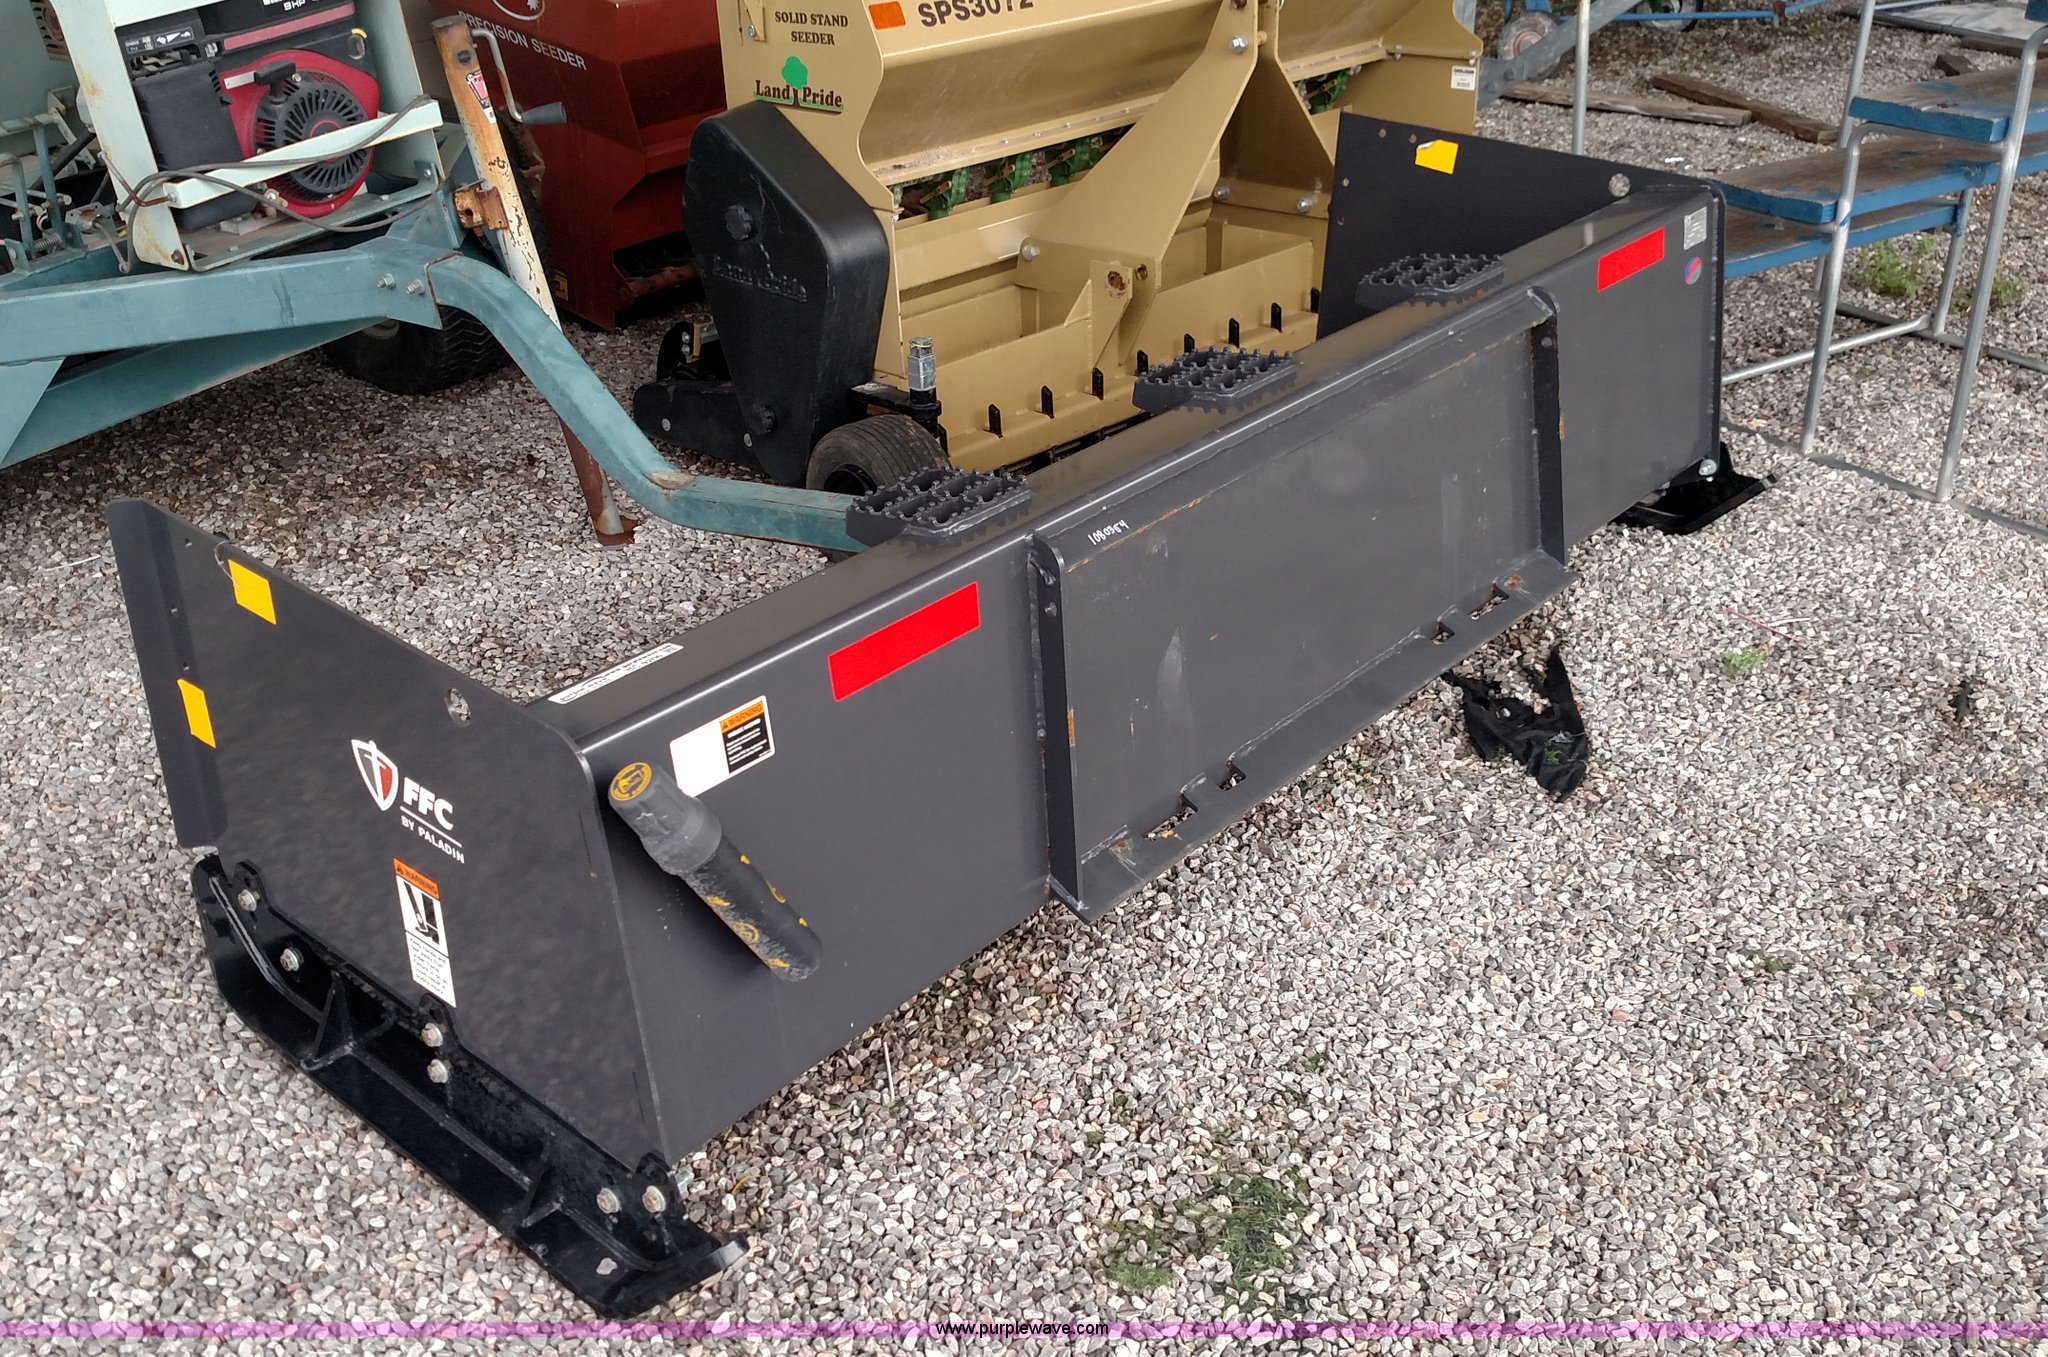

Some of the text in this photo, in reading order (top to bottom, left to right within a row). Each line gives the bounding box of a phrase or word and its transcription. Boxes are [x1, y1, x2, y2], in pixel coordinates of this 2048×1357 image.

[775, 13, 848, 27] SOLID STAND
[791, 31, 835, 46] SEEDER
[458, 10, 587, 71] PRECISION SEEDER
[755, 80, 843, 108] Land Pride
[403, 777, 454, 831] FFC
[401, 815, 465, 864] BY PALADIN
